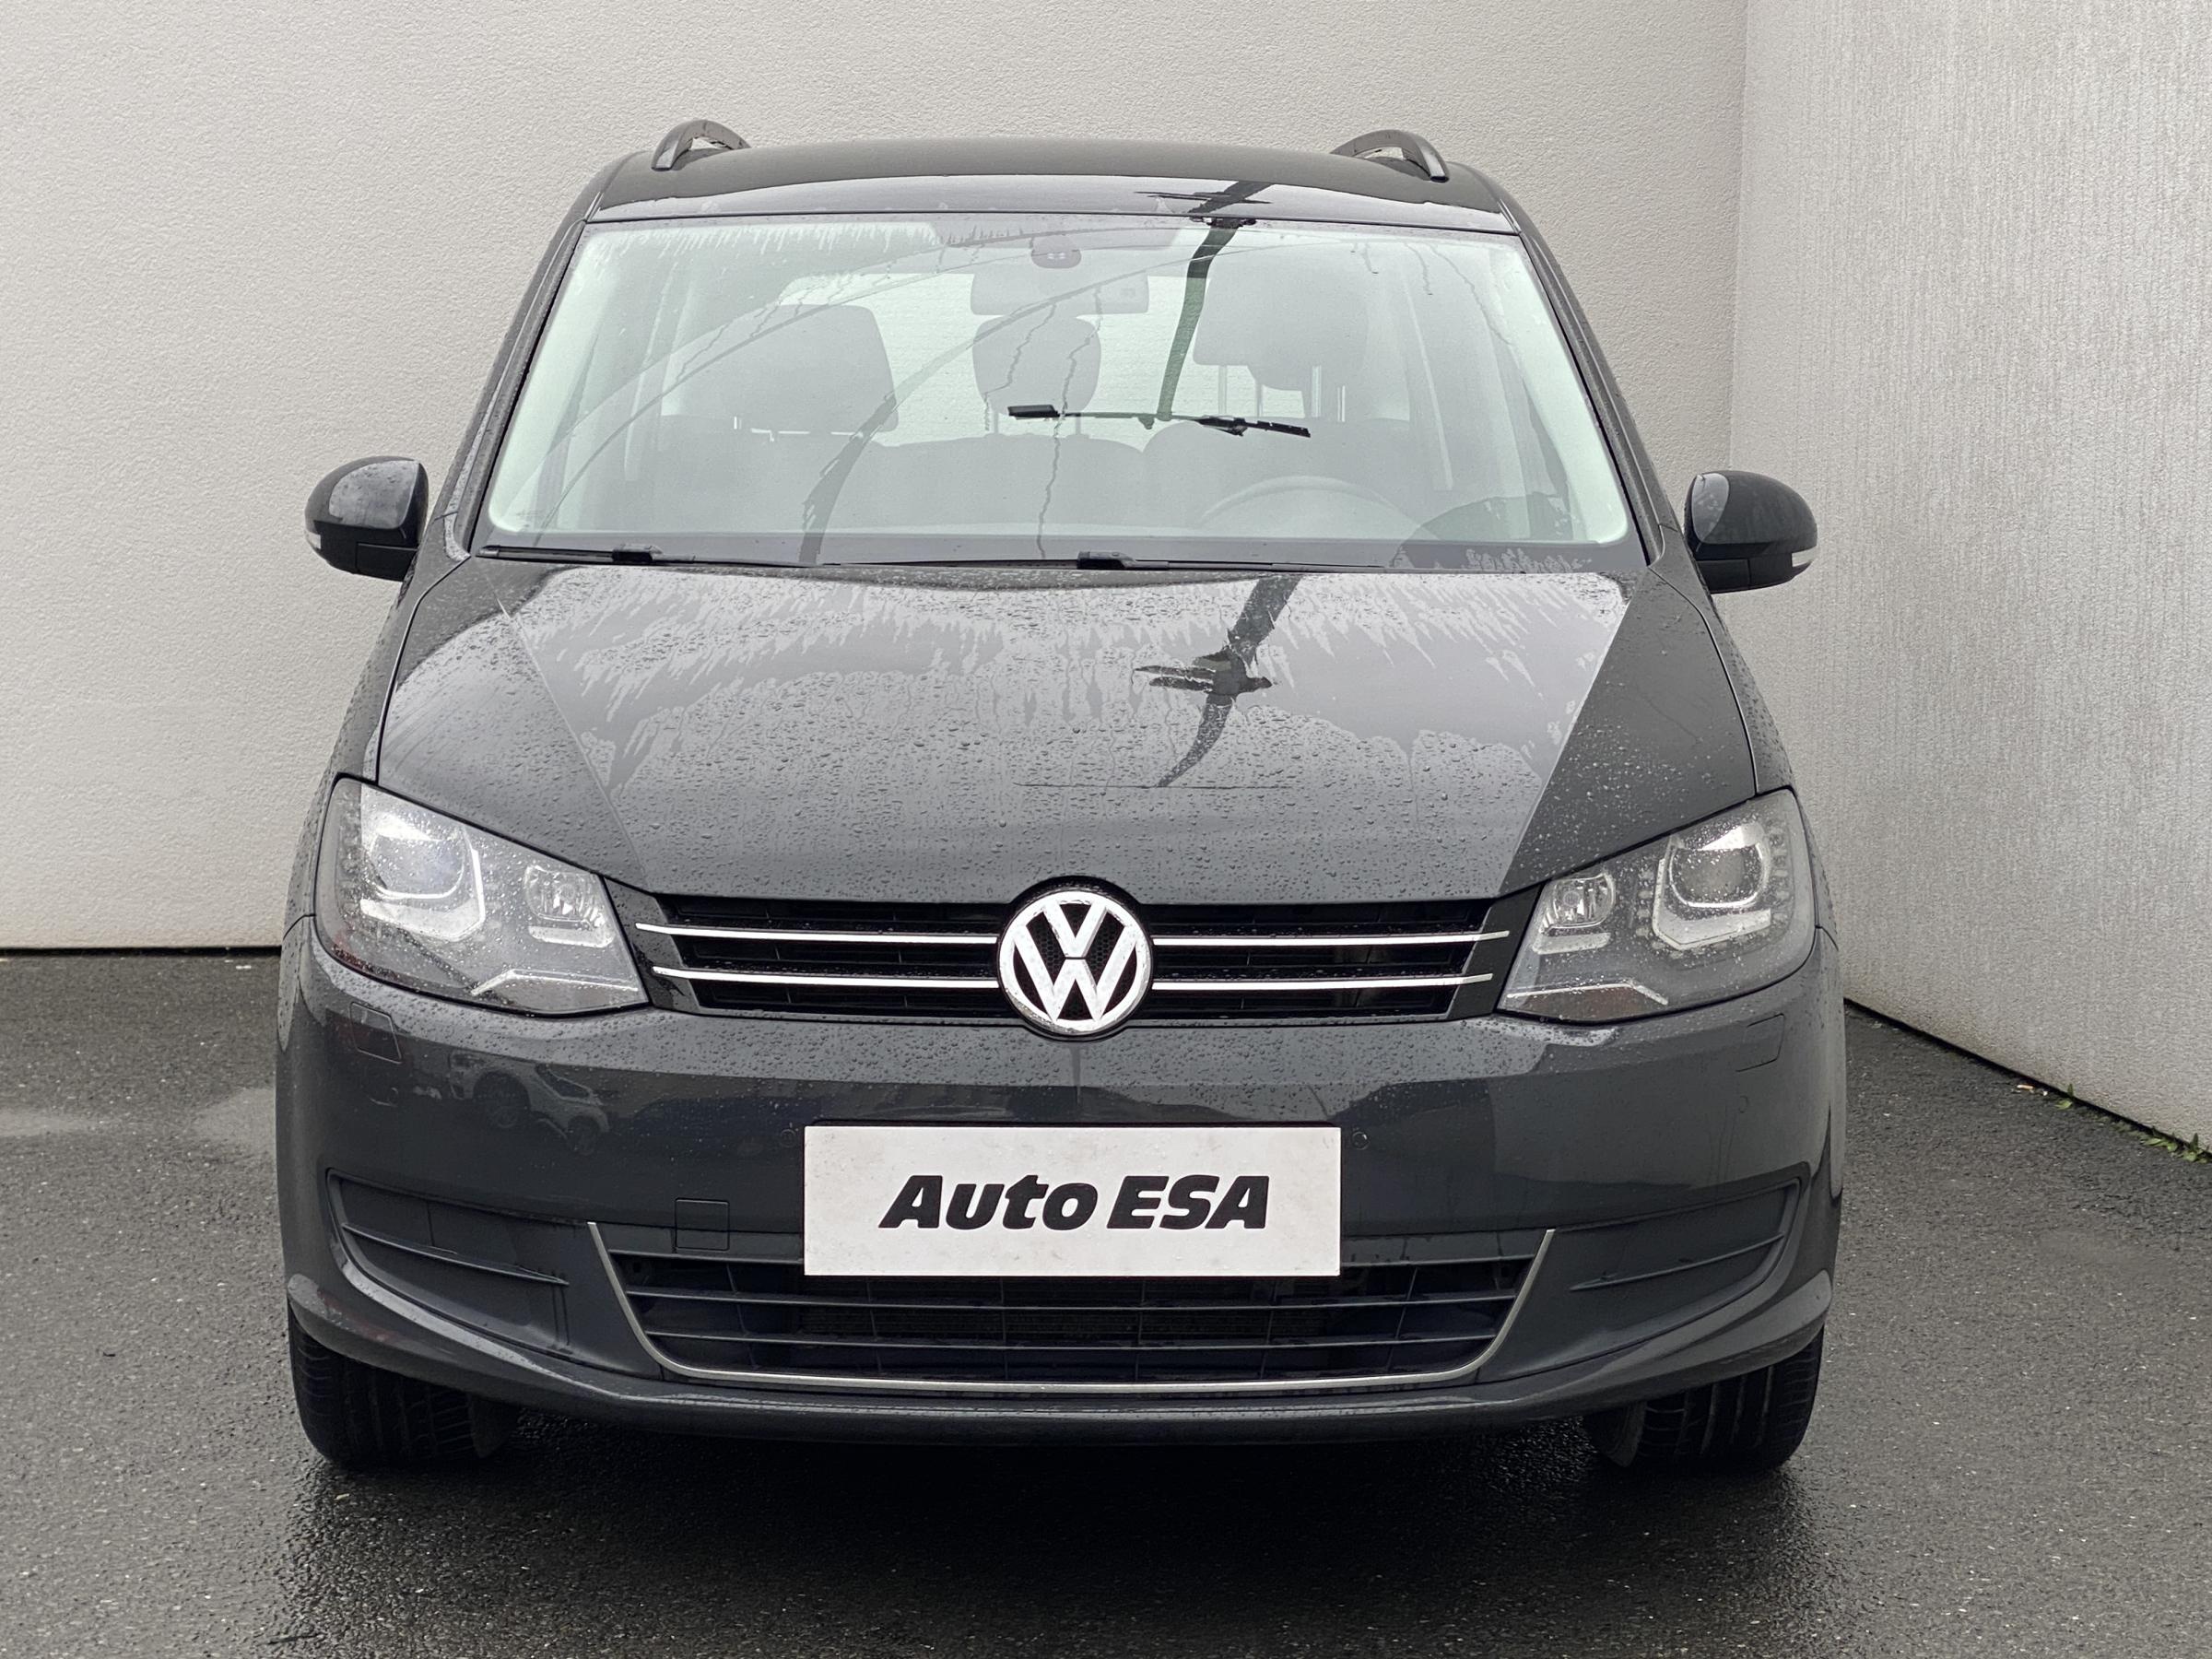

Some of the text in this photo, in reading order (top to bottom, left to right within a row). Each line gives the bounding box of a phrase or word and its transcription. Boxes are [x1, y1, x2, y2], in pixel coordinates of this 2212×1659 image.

[1008, 895, 1143, 1027] VW
[878, 1174, 1270, 1230] Auto ESA
